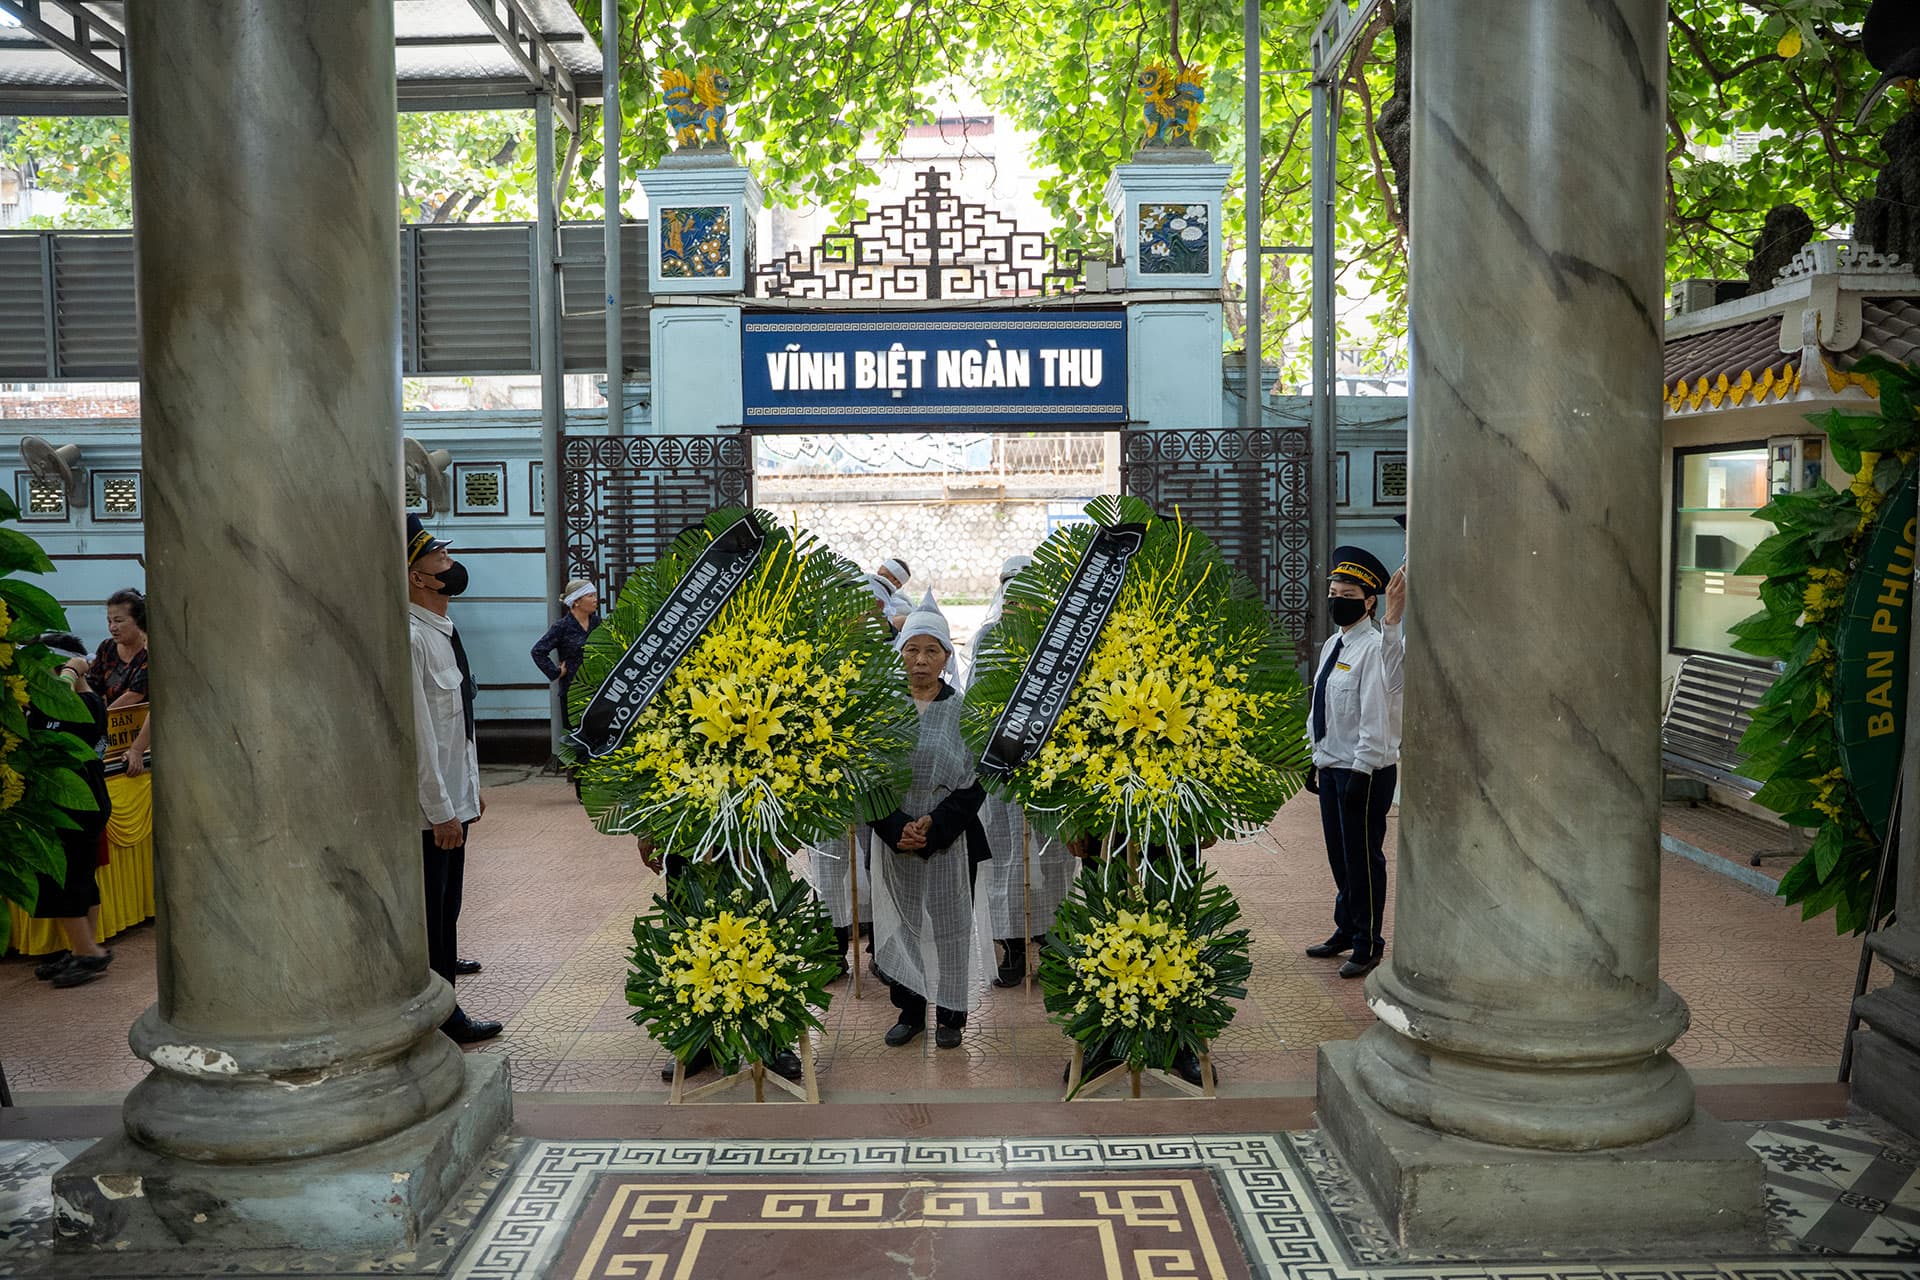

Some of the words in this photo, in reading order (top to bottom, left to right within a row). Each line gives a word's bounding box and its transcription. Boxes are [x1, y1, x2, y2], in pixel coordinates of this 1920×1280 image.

[766, 343, 845, 391] VĨNH
[855, 342, 926, 398] BIỆT
[937, 339, 1030, 389] NGÀN
[1040, 348, 1103, 387] THU
[1081, 551, 1110, 595] NGOẠI
[1067, 591, 1090, 617] NỘI
[604, 677, 629, 704] VỢ
[624, 666, 640, 681] &
[633, 634, 663, 666] CÁC
[657, 604, 688, 635] CON
[681, 561, 718, 602] CHÁU
[608, 705, 631, 731] VÔ
[628, 661, 666, 703] CÙNG
[661, 597, 714, 659] THƯƠNG
[710, 562, 743, 598] TIẾC
[1023, 719, 1045, 746] VÔ
[1039, 671, 1069, 717] CÙNG
[1063, 602, 1105, 668] THƯƠNG
[1097, 563, 1123, 600] TIẾC
[1047, 615, 1076, 650] ĐÌNH
[1035, 650, 1060, 676] GIA
[1021, 671, 1047, 706] THỂ
[1865, 650, 1895, 738] BAN
[1002, 699, 1035, 742] TOÀN
